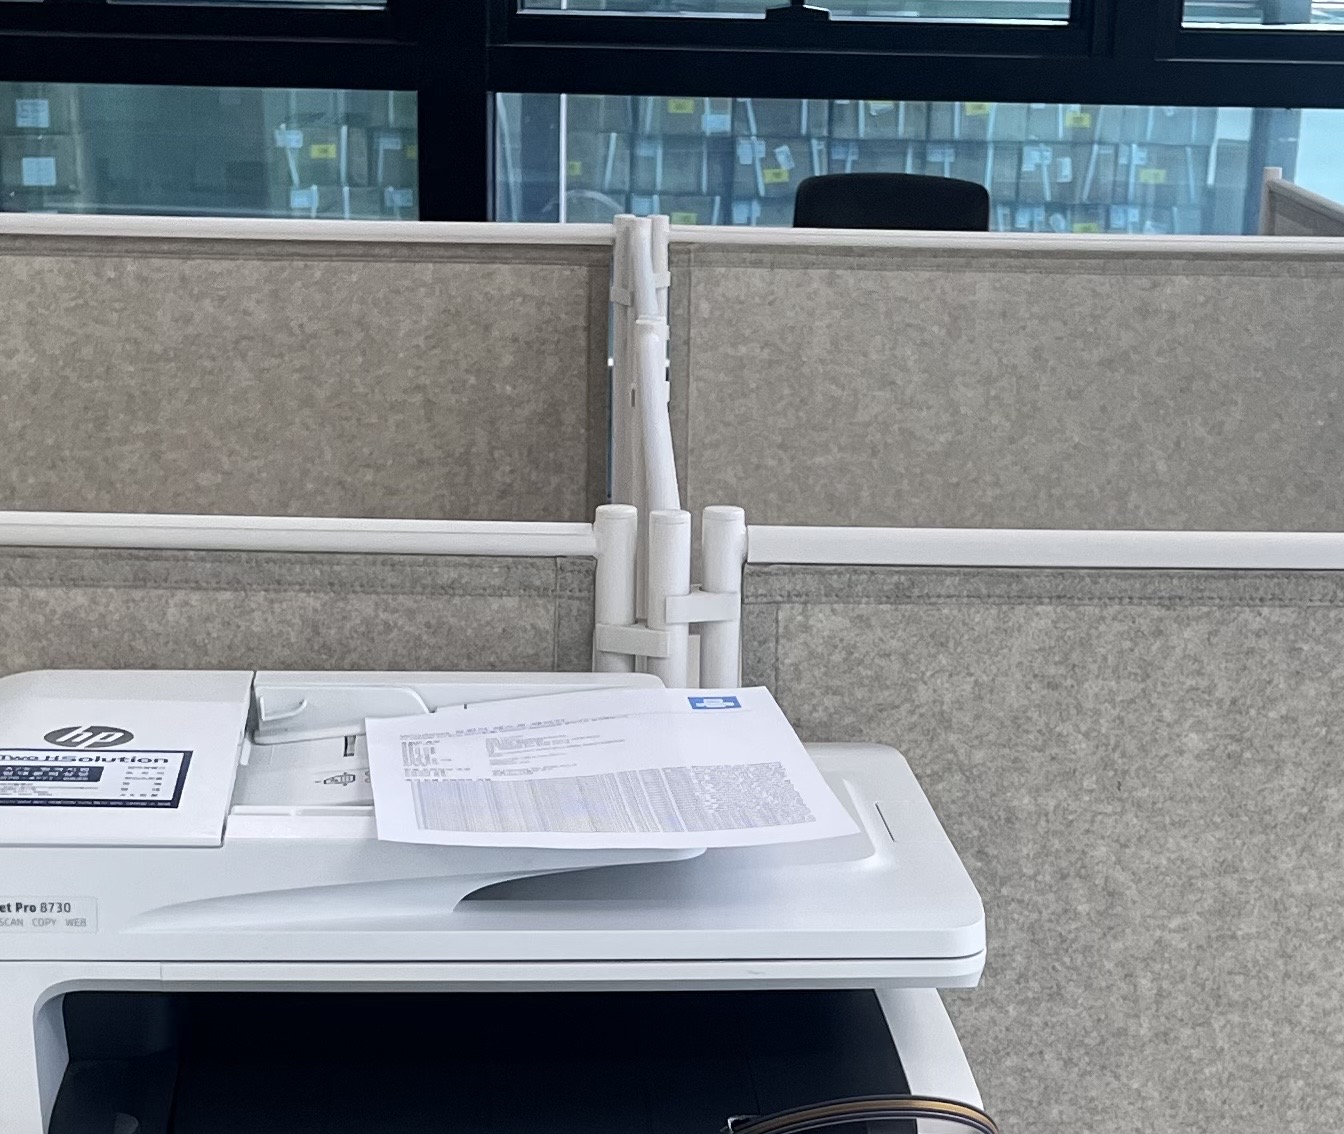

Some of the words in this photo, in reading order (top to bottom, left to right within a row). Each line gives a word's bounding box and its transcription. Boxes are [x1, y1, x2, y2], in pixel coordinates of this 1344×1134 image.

[55, 726, 125, 748] hp
[15, 902, 37, 913] Pro
[40, 902, 71, 913] 8730
[32, 917, 57, 927] COPY
[65, 918, 87, 927] WEB
